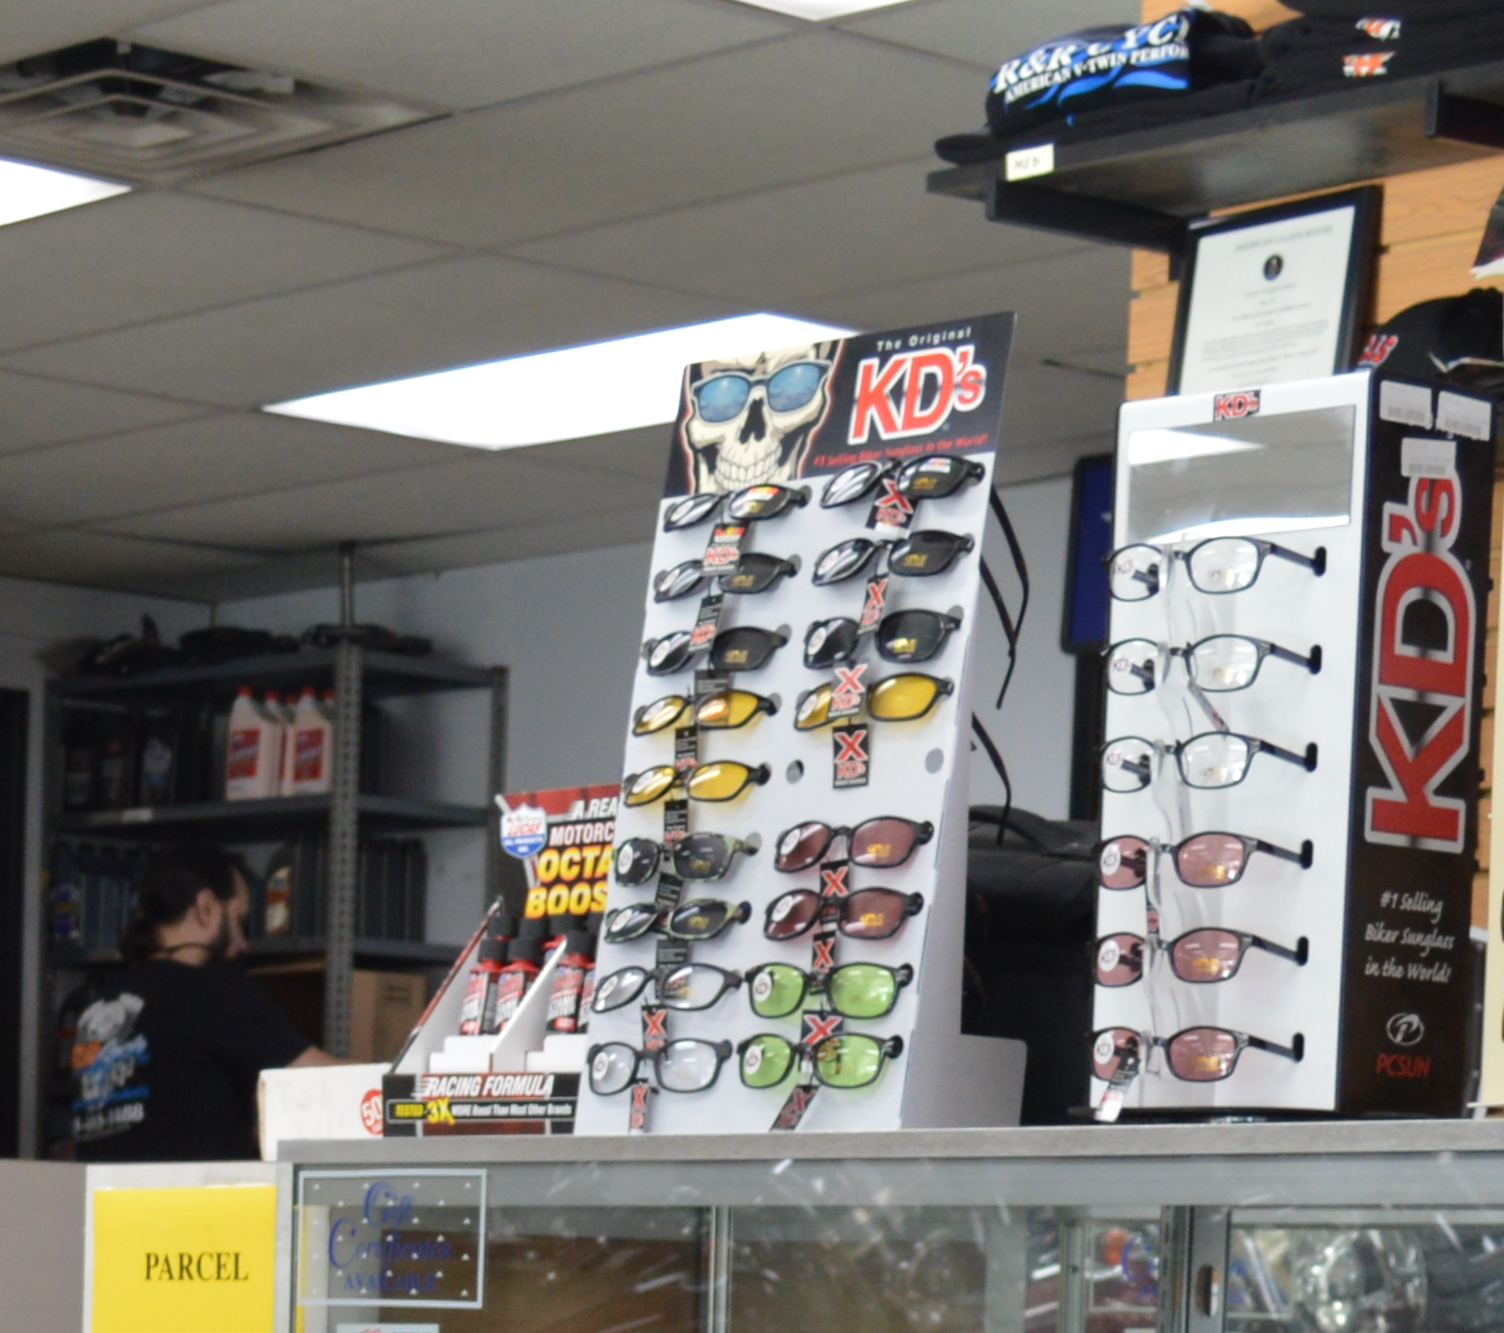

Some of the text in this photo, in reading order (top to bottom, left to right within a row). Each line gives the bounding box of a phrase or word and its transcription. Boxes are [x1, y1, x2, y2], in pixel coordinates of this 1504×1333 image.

[993, 45, 1077, 94] R&R
[1005, 67, 1071, 103] AMERICAN
[876, 326, 972, 352] The Original
[848, 344, 987, 445] KD's
[1364, 476, 1476, 854] KD's
[572, 800, 585, 820] A
[550, 821, 615, 847] MOTORC
[1380, 890, 1444, 924] #1 Selling
[1364, 921, 1455, 957] Biker Sunglass
[1364, 956, 1451, 984] in the World!
[1376, 1053, 1432, 1077] PCSUN
[426, 1075, 555, 1097] RACING FORMULA
[144, 1251, 250, 1281] PARCEL
